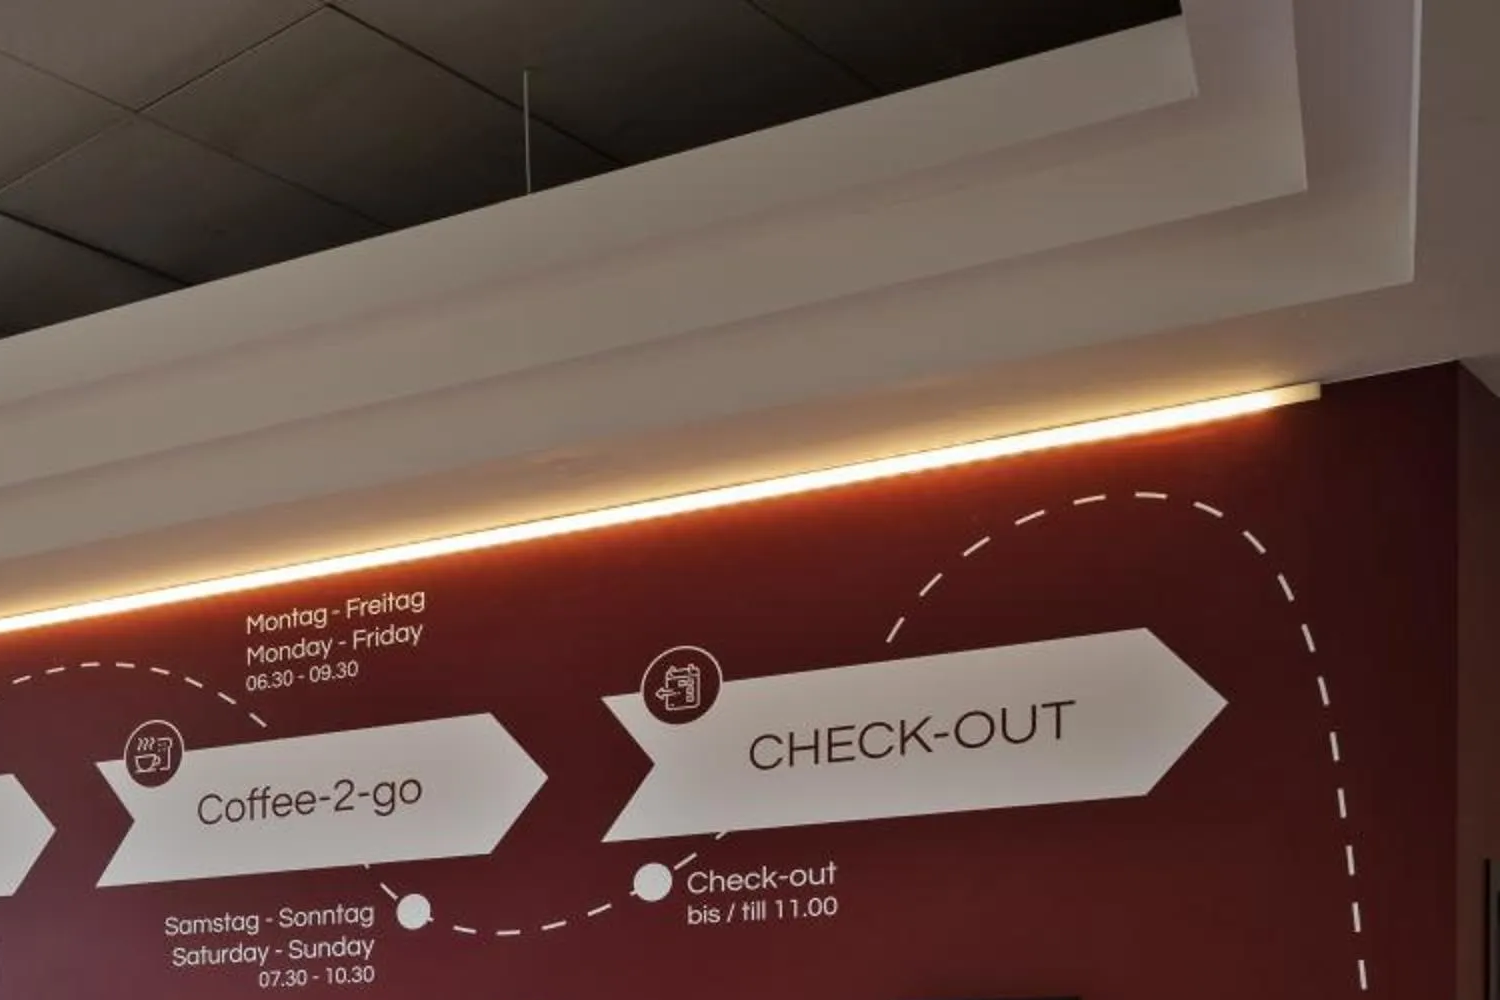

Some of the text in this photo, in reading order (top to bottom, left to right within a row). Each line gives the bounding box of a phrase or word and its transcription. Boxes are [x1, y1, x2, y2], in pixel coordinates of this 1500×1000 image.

[245, 607, 328, 635] Montag
[345, 590, 426, 620] Freitag
[246, 637, 333, 667] Monday
[352, 623, 424, 650] Friday
[245, 669, 293, 692] 06.30
[308, 660, 359, 683] 09.30
[748, 700, 1077, 771] CHECK-OUT
[196, 776, 423, 826] Coffee-2-go
[686, 860, 838, 895] Check-out
[164, 911, 260, 937] Samstag
[278, 903, 375, 928] Sonntag
[686, 896, 839, 925] bis / till 11.00
[171, 941, 270, 967] Saturday
[287, 935, 376, 960] Sunday
[258, 968, 308, 988] 07.30
[325, 965, 375, 984] 10.30
